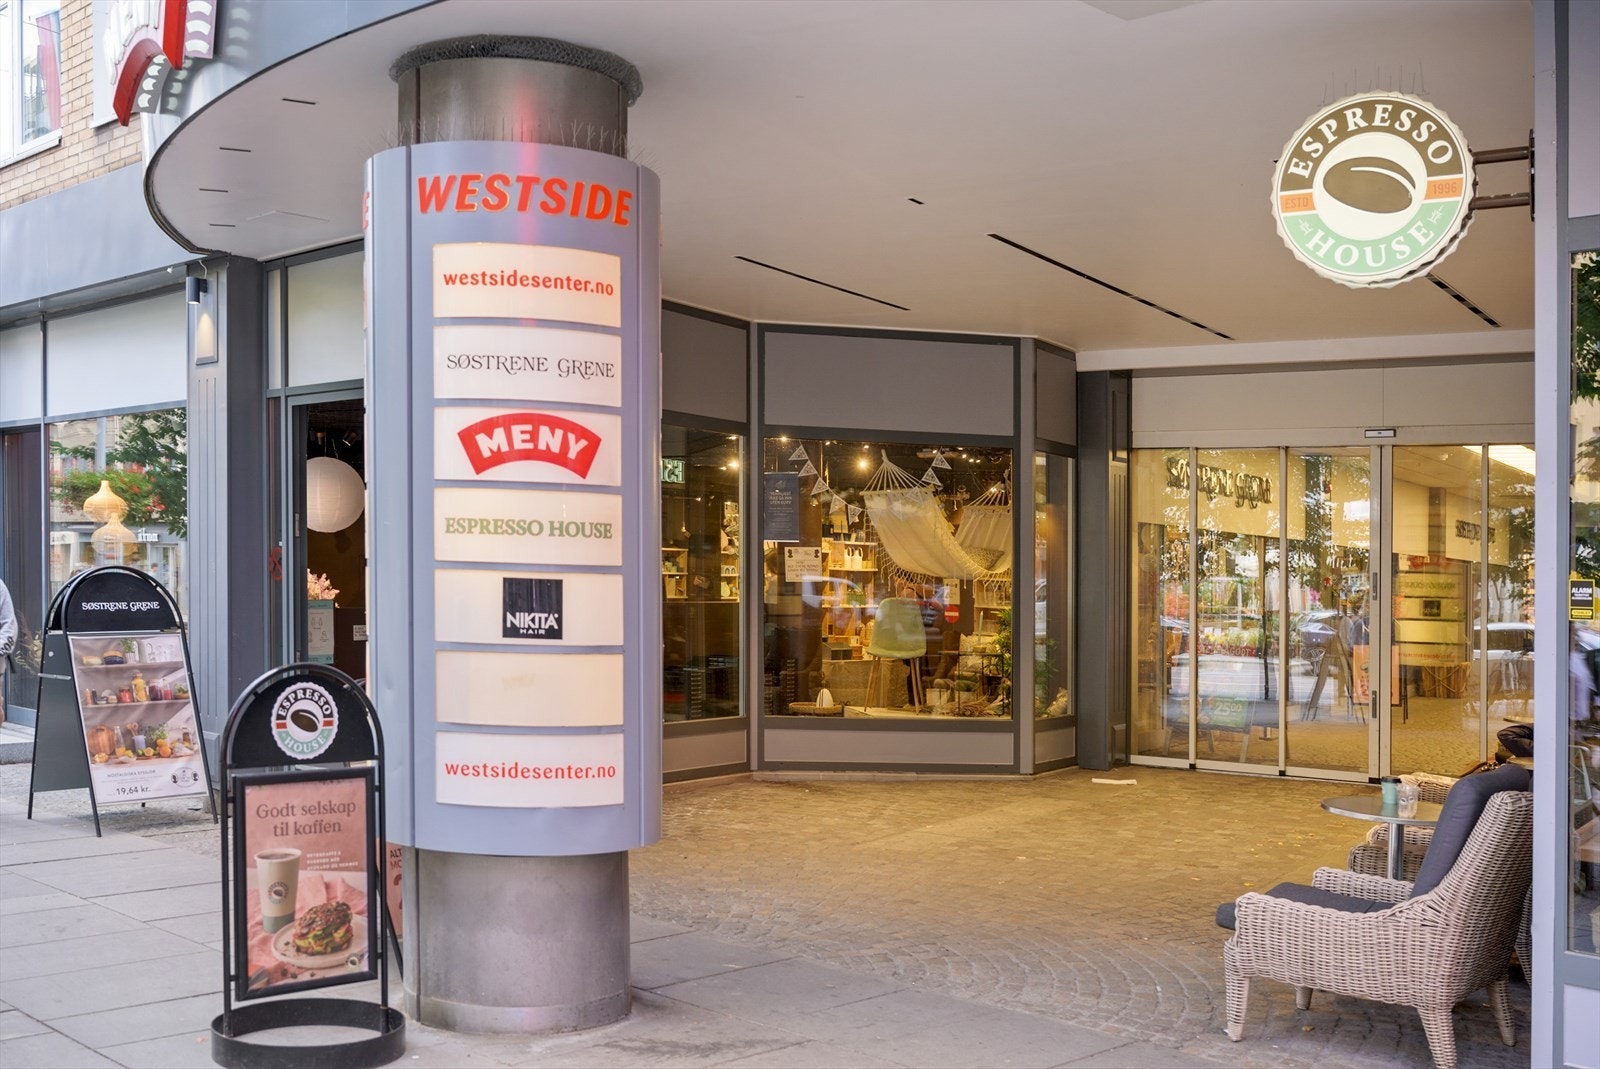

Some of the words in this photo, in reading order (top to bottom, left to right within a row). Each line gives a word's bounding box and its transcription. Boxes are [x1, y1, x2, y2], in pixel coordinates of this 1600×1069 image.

[1288, 104, 1453, 179] ESPRESSO
[1432, 182, 1457, 194] 1996
[417, 173, 633, 227] WESTSIDE
[1305, 221, 1435, 267] HOUSE
[443, 270, 614, 296] westsidesenter.no
[447, 354, 548, 376] SØSTRENE
[557, 358, 615, 379] GRENE
[474, 424, 589, 460] MENY
[444, 517, 544, 537] ESPRESSO
[548, 520, 613, 539] HOUSE
[81, 601, 129, 612] SØSTRENE
[129, 601, 160, 612] GRENE
[506, 612, 557, 629] NIKITA
[278, 688, 332, 717] ESPRESSO
[284, 735, 326, 753] HOUSE
[445, 762, 616, 780] westsidesenter.no
[116, 786, 139, 796] 19,64
[140, 785, 151, 793] kr.
[256, 803, 296, 819] Godt
[301, 800, 356, 817] selskap
[273, 822, 289, 837] til
[294, 820, 342, 835] kaffen
